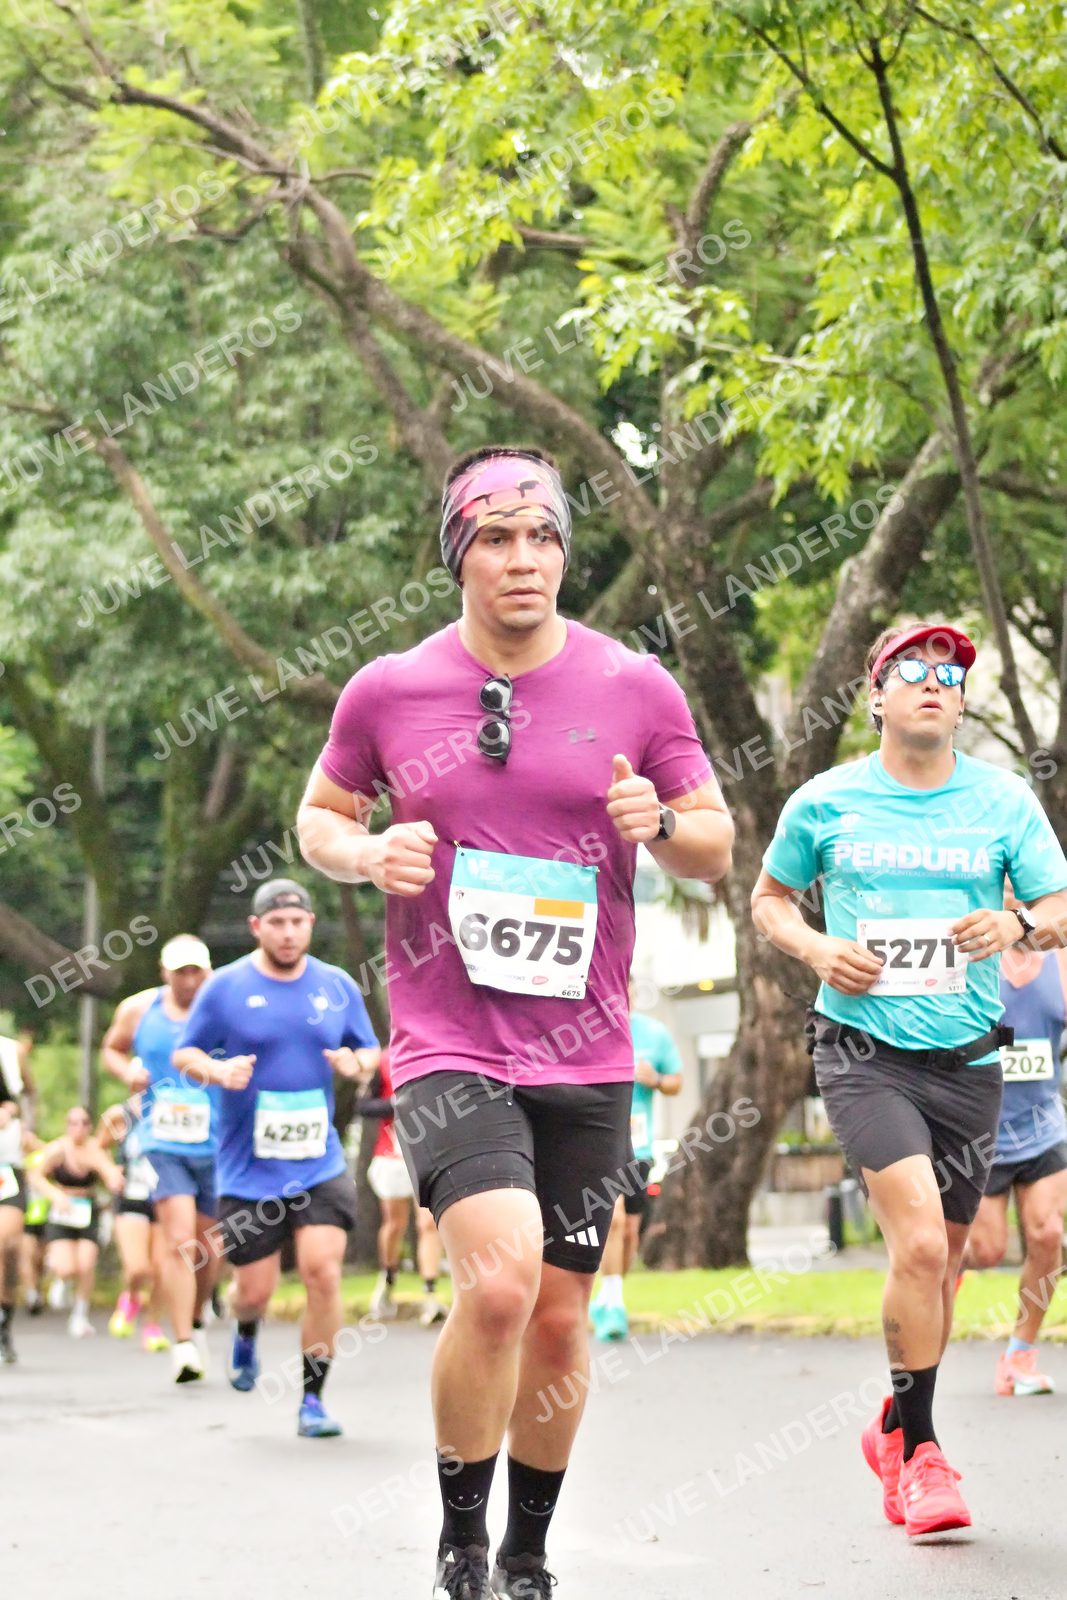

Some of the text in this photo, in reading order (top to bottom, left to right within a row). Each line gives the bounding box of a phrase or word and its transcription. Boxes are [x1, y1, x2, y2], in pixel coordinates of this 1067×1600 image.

[833, 842, 991, 873] PERDURA
[459, 913, 585, 966] 6675
[866, 938, 955, 968] 5271
[561, 989, 582, 998] 6675
[1003, 1056, 1046, 1074] 202
[264, 1121, 323, 1143] 4297
